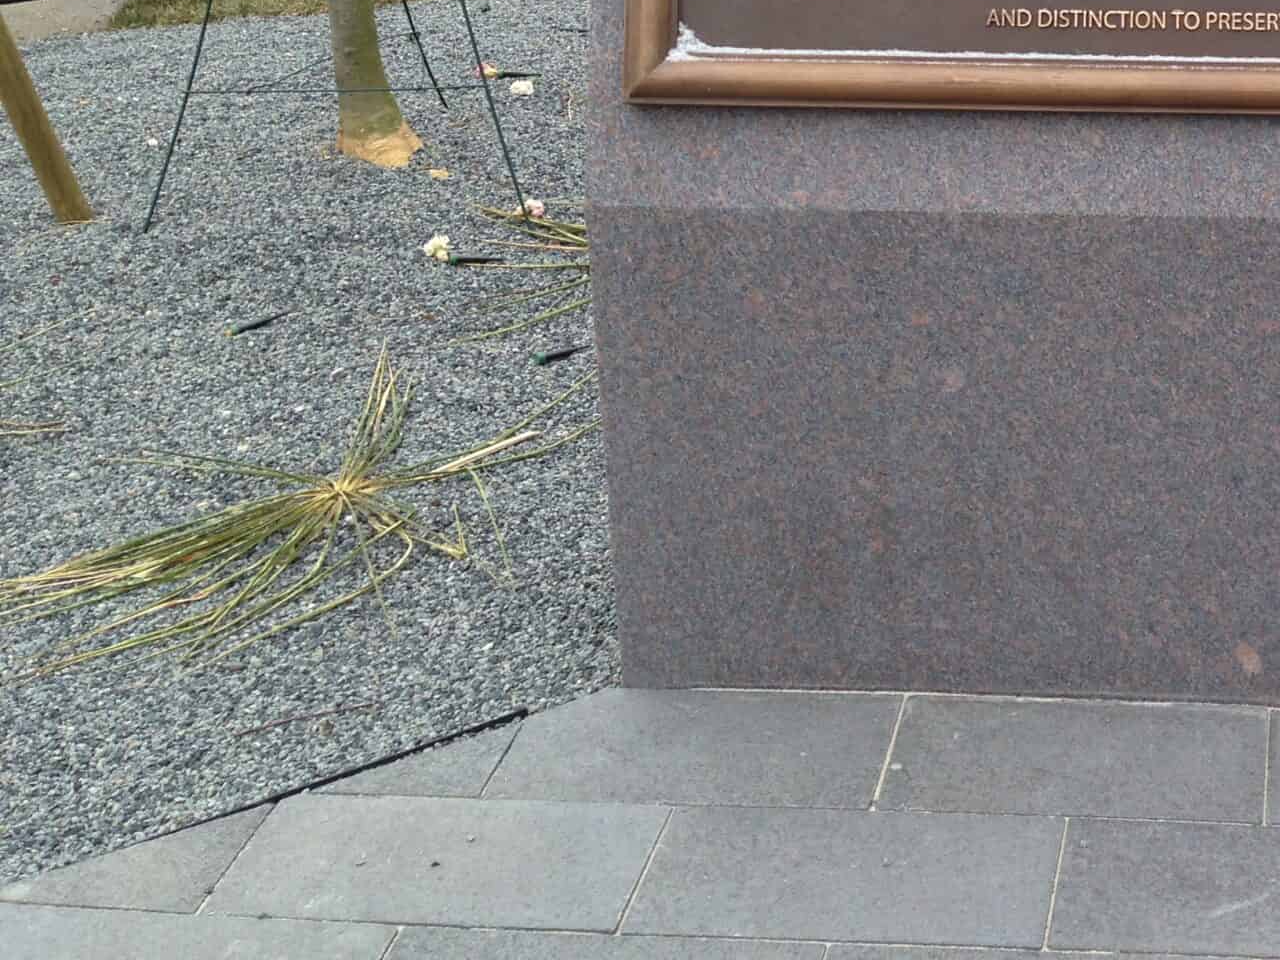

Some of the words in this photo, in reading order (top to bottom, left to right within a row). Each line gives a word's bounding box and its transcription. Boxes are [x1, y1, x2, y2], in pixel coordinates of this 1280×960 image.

[986, 7, 1033, 27] AND
[1037, 7, 1167, 30] DISTINCTION
[1170, 8, 1201, 31] TO
